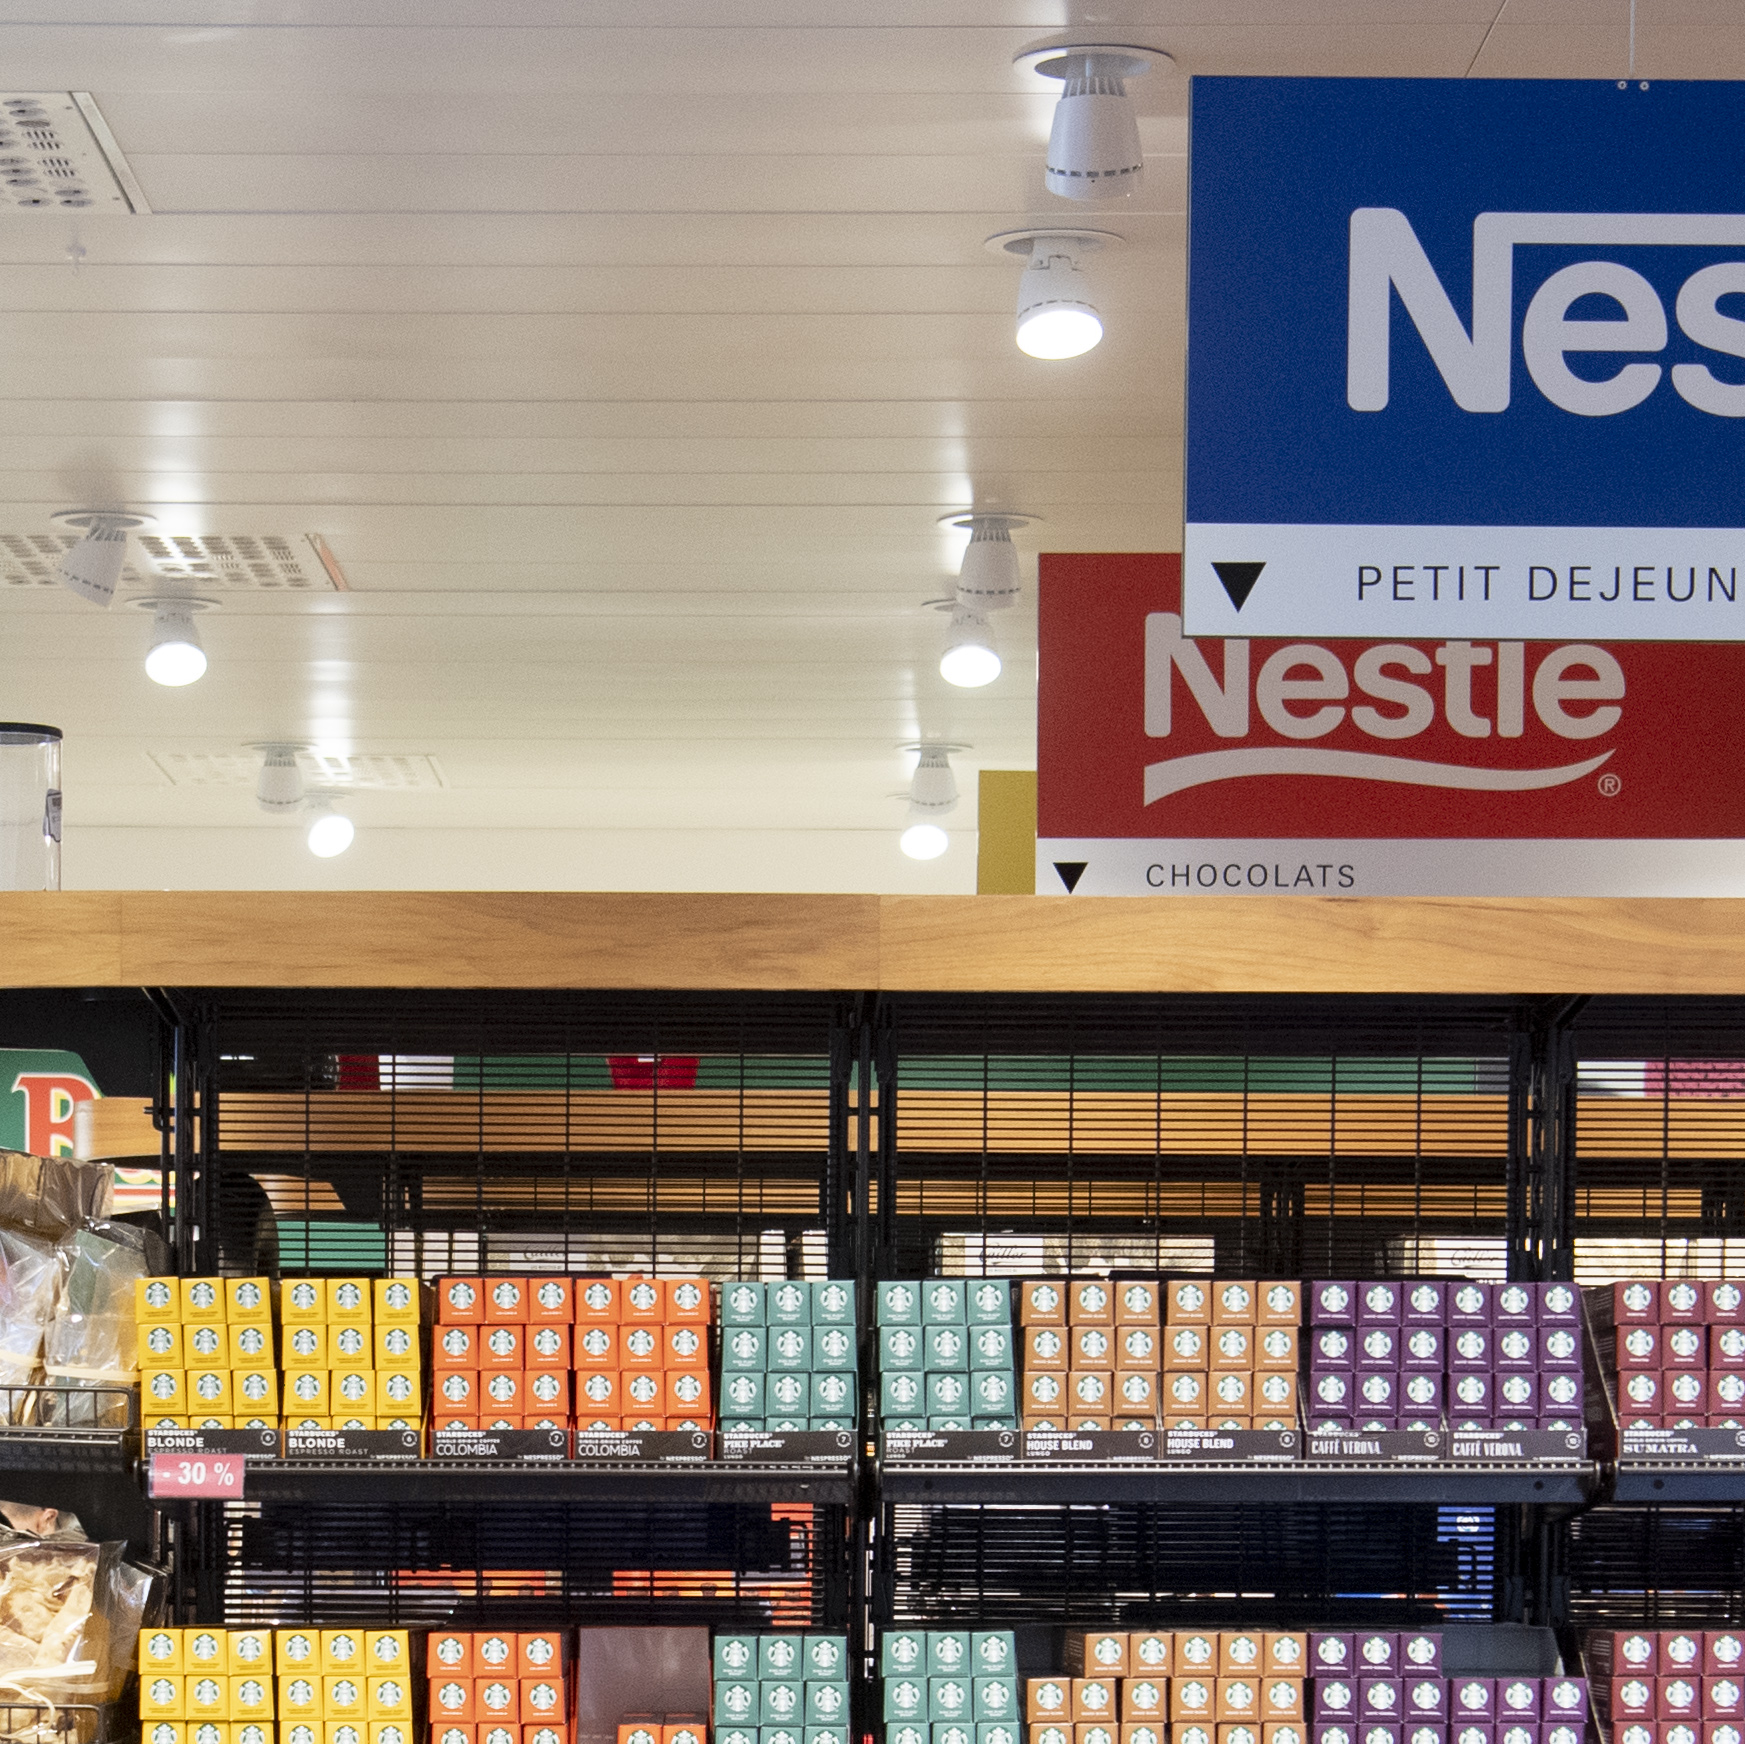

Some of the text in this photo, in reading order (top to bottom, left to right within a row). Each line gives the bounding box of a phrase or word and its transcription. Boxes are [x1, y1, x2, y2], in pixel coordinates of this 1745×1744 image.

[1358, 566, 1501, 604] PETIT
[1146, 863, 1356, 889] CHOCOLATS
[148, 1437, 204, 1448] BLONDE
[289, 1438, 345, 1448] BLONDE
[724, 1440, 782, 1448] PIKE PLACE
[886, 1440, 945, 1448] PIKE PLACE
[1027, 1440, 1093, 1450] HOUSE BLEND
[1168, 1439, 1234, 1449] HOUSE BLEND
[1343, 1440, 1380, 1454] VERONA
[436, 1445, 498, 1456] COLOMBIA
[579, 1445, 640, 1456] COLOMBIA
[1483, 1441, 1522, 1457] VERONA
[1623, 1444, 1698, 1454] SUMATRA
[177, 1462, 205, 1485] 30
[213, 1462, 235, 1486] %
